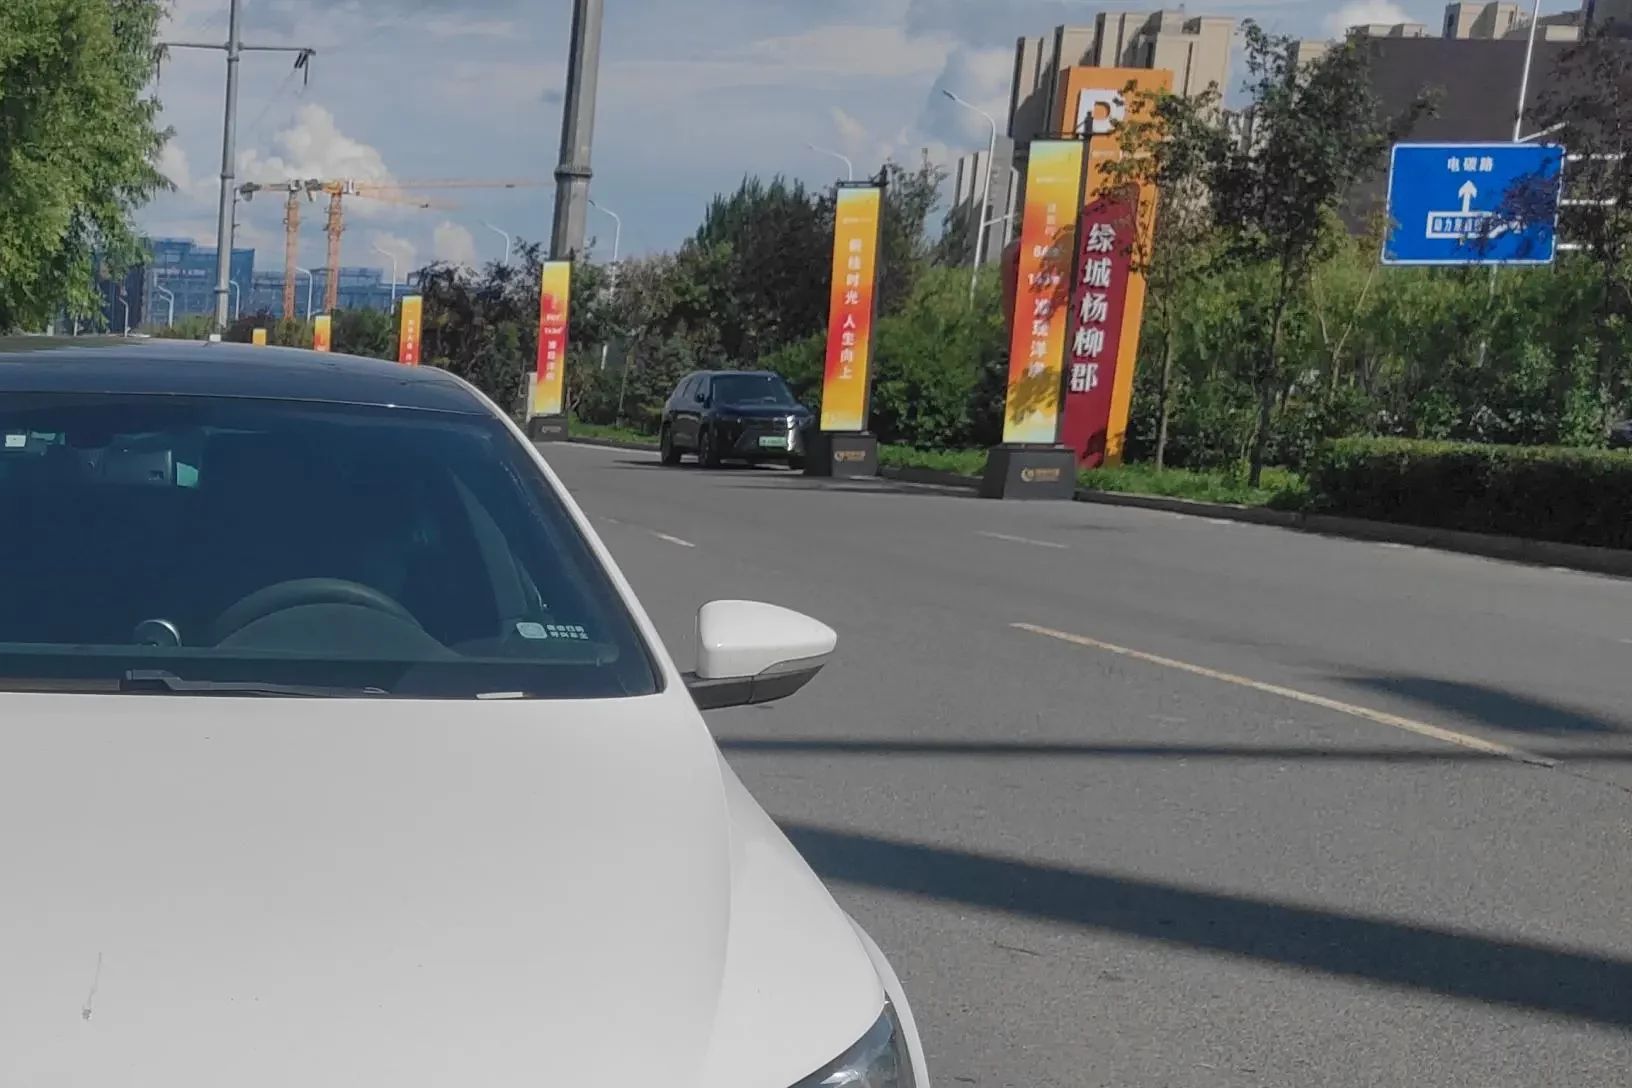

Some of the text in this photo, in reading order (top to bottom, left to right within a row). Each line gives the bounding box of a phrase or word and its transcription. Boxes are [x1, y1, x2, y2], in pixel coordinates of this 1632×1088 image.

[838, 313, 856, 381] 人生向上
[1070, 223, 1116, 392] 绿城杨柳郡
